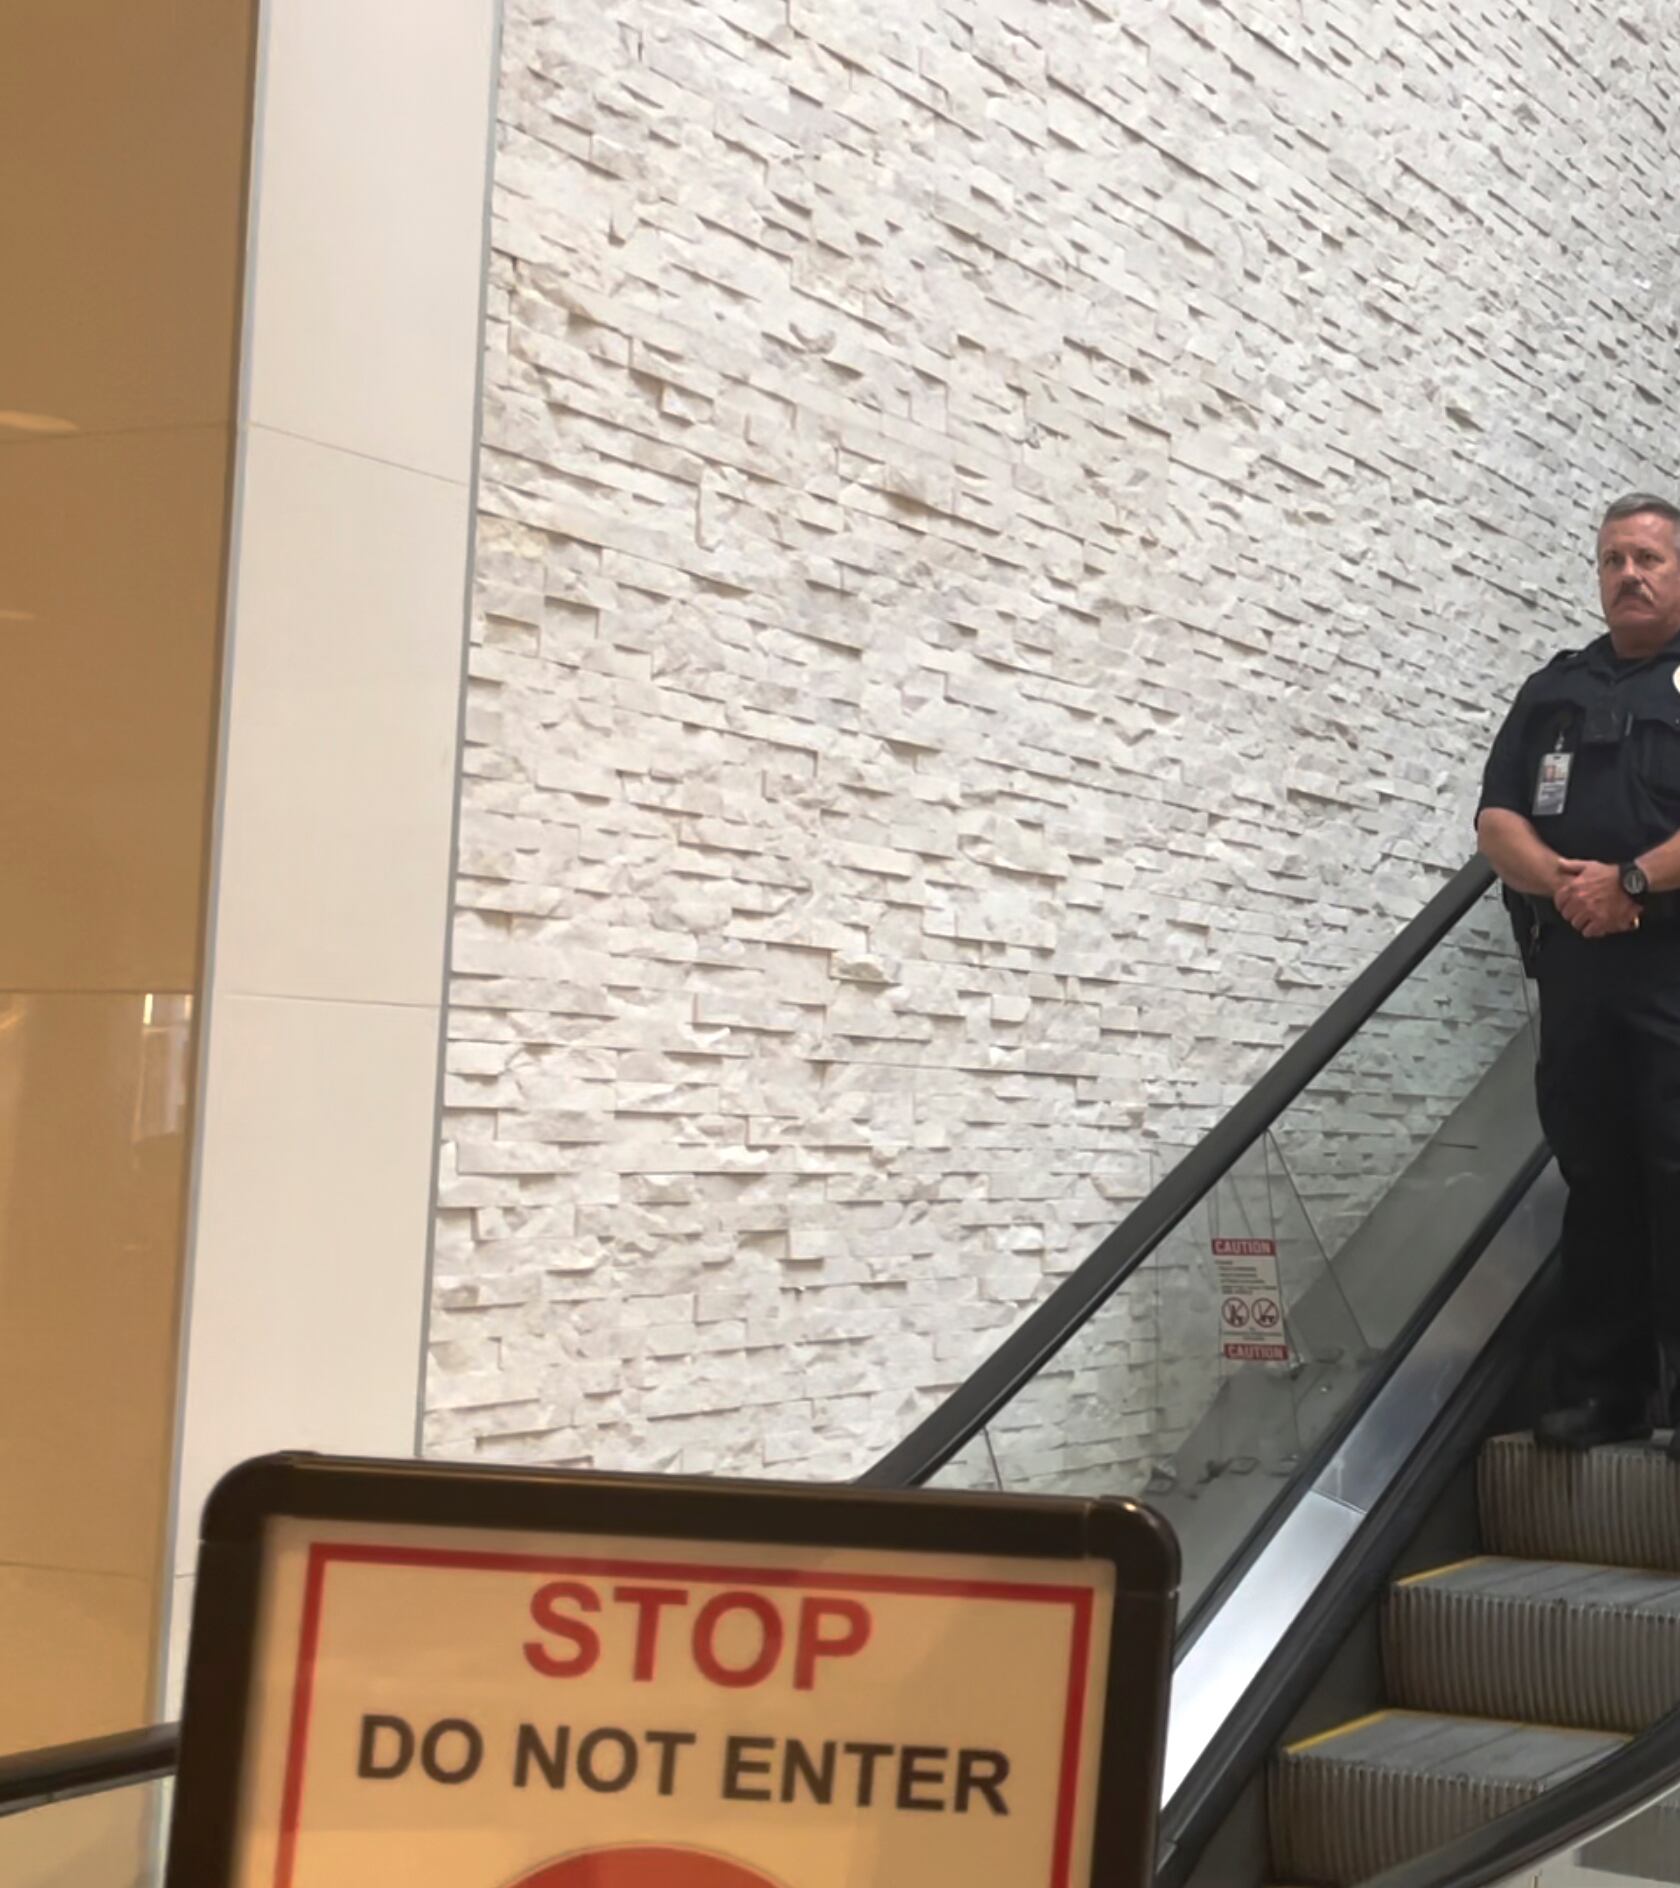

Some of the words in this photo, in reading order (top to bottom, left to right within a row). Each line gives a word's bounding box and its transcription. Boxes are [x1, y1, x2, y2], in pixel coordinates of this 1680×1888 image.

[1215, 1239, 1272, 1254] CAUTION
[1228, 1345, 1284, 1360] CAUTION
[522, 1580, 873, 1692] STOP
[356, 1713, 484, 1786] DO
[513, 1722, 697, 1797] NOT
[720, 1734, 1011, 1817] ENTER
